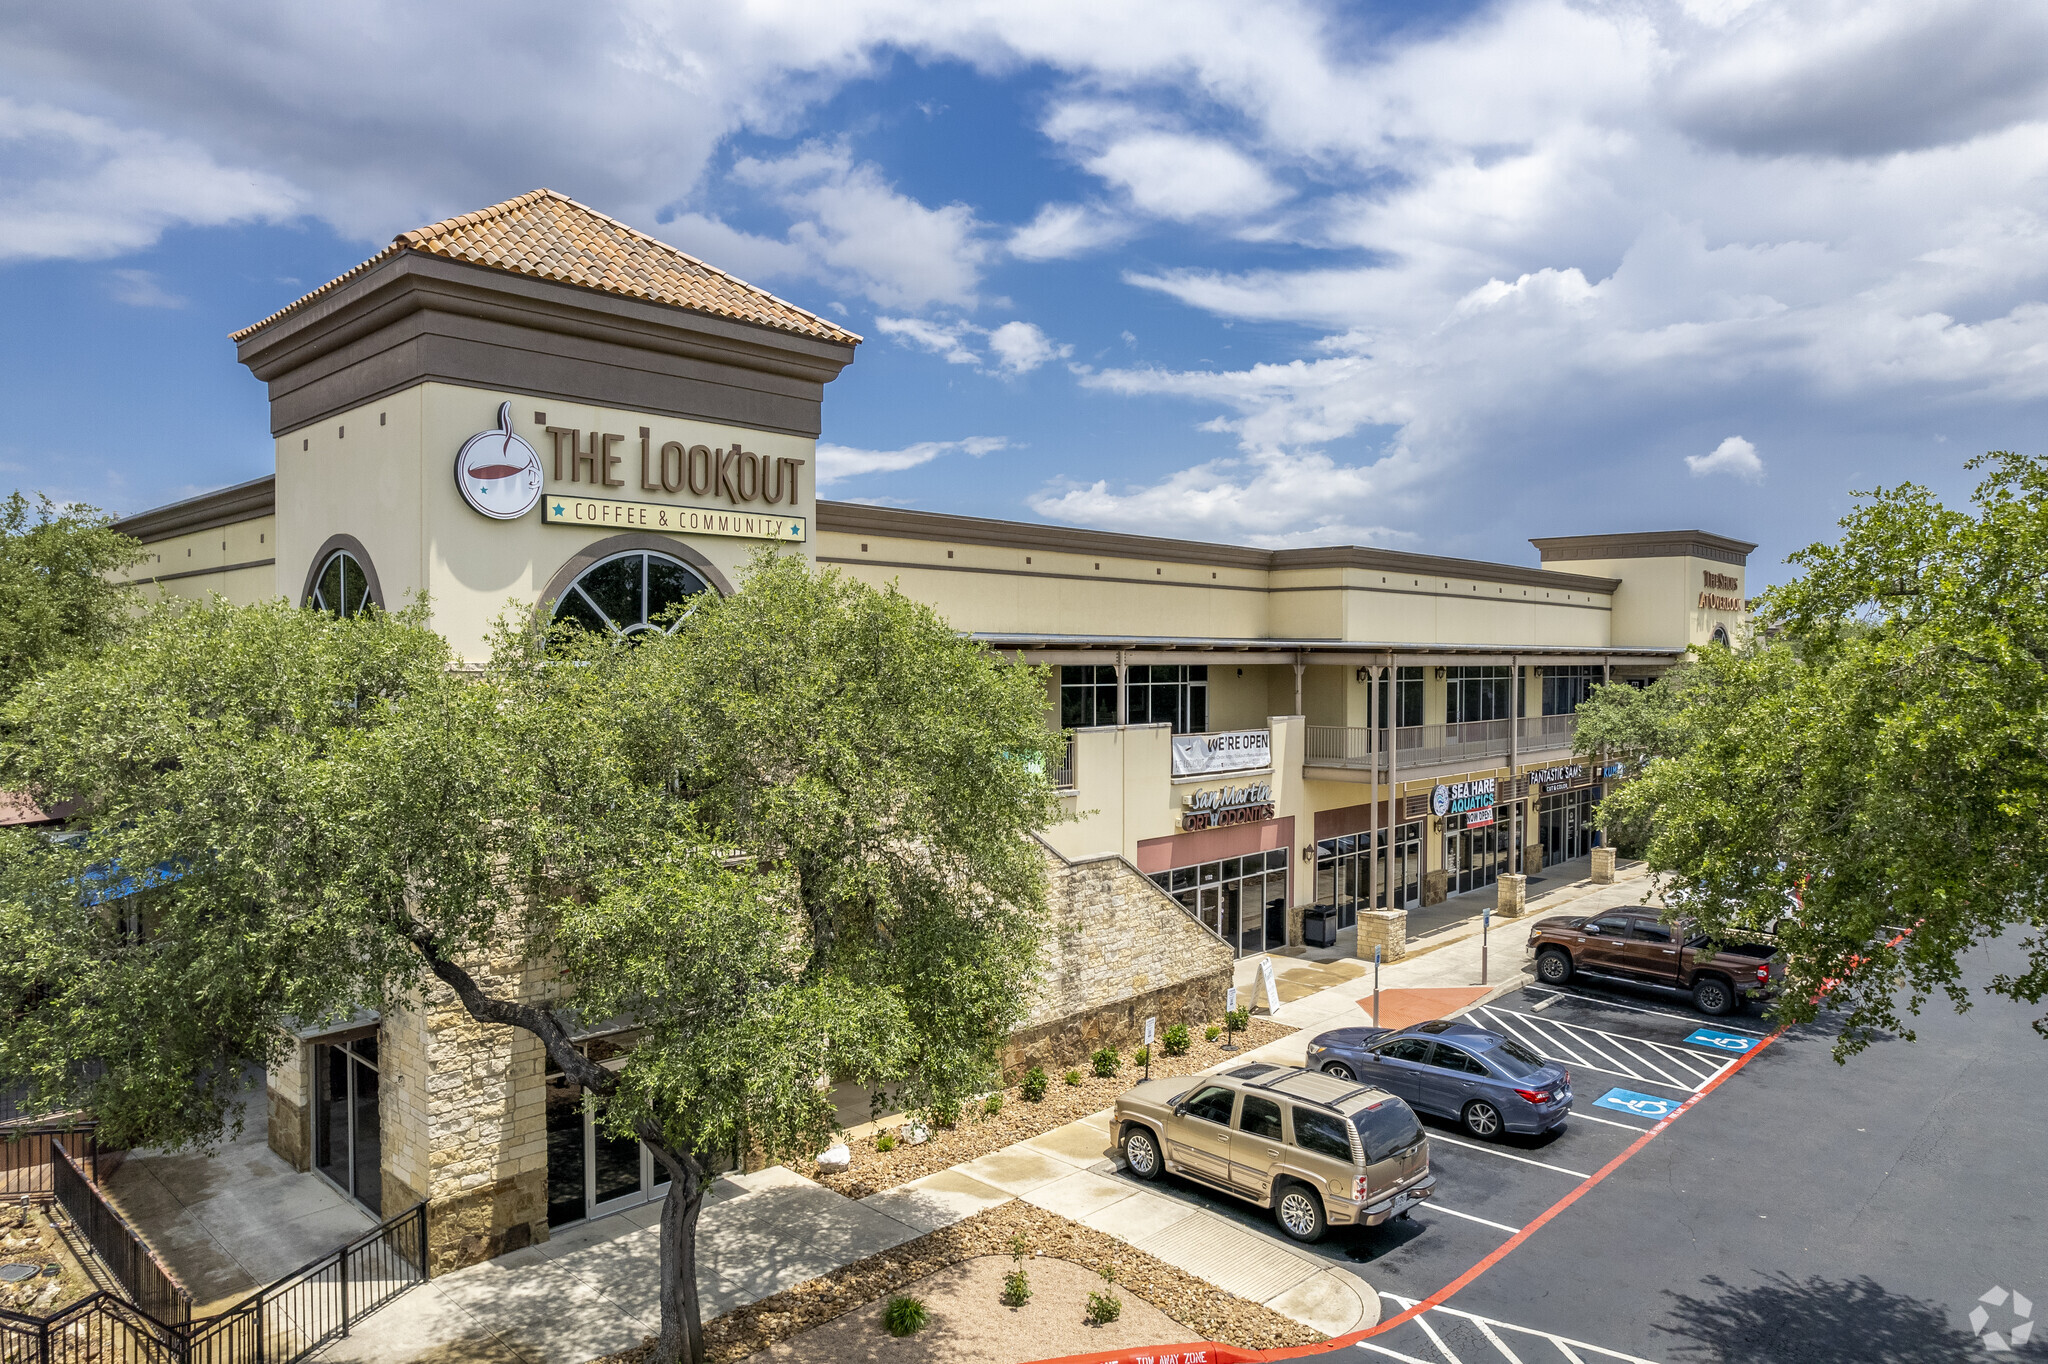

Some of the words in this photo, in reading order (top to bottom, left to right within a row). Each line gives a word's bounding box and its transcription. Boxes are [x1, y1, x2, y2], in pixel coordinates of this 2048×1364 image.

[546, 426, 625, 486] THE
[574, 502, 647, 526] COFFEE
[658, 510, 669, 528] &
[678, 511, 784, 537] COMMUNITY
[1207, 736, 1241, 752] WE'RE
[1243, 734, 1268, 749] OPEN
[1530, 766, 1564, 785] FANTASTIC
[1192, 787, 1219, 810] San
[1220, 781, 1273, 807] Martin
[1451, 783, 1470, 800] SEA
[1471, 778, 1494, 795] HARE
[1451, 793, 1495, 814] AQUATICS
[1184, 804, 1275, 831] ORTHODONTICS
[1159, 1353, 1180, 1364] AWAY
[1183, 1351, 1207, 1364] ZONE
